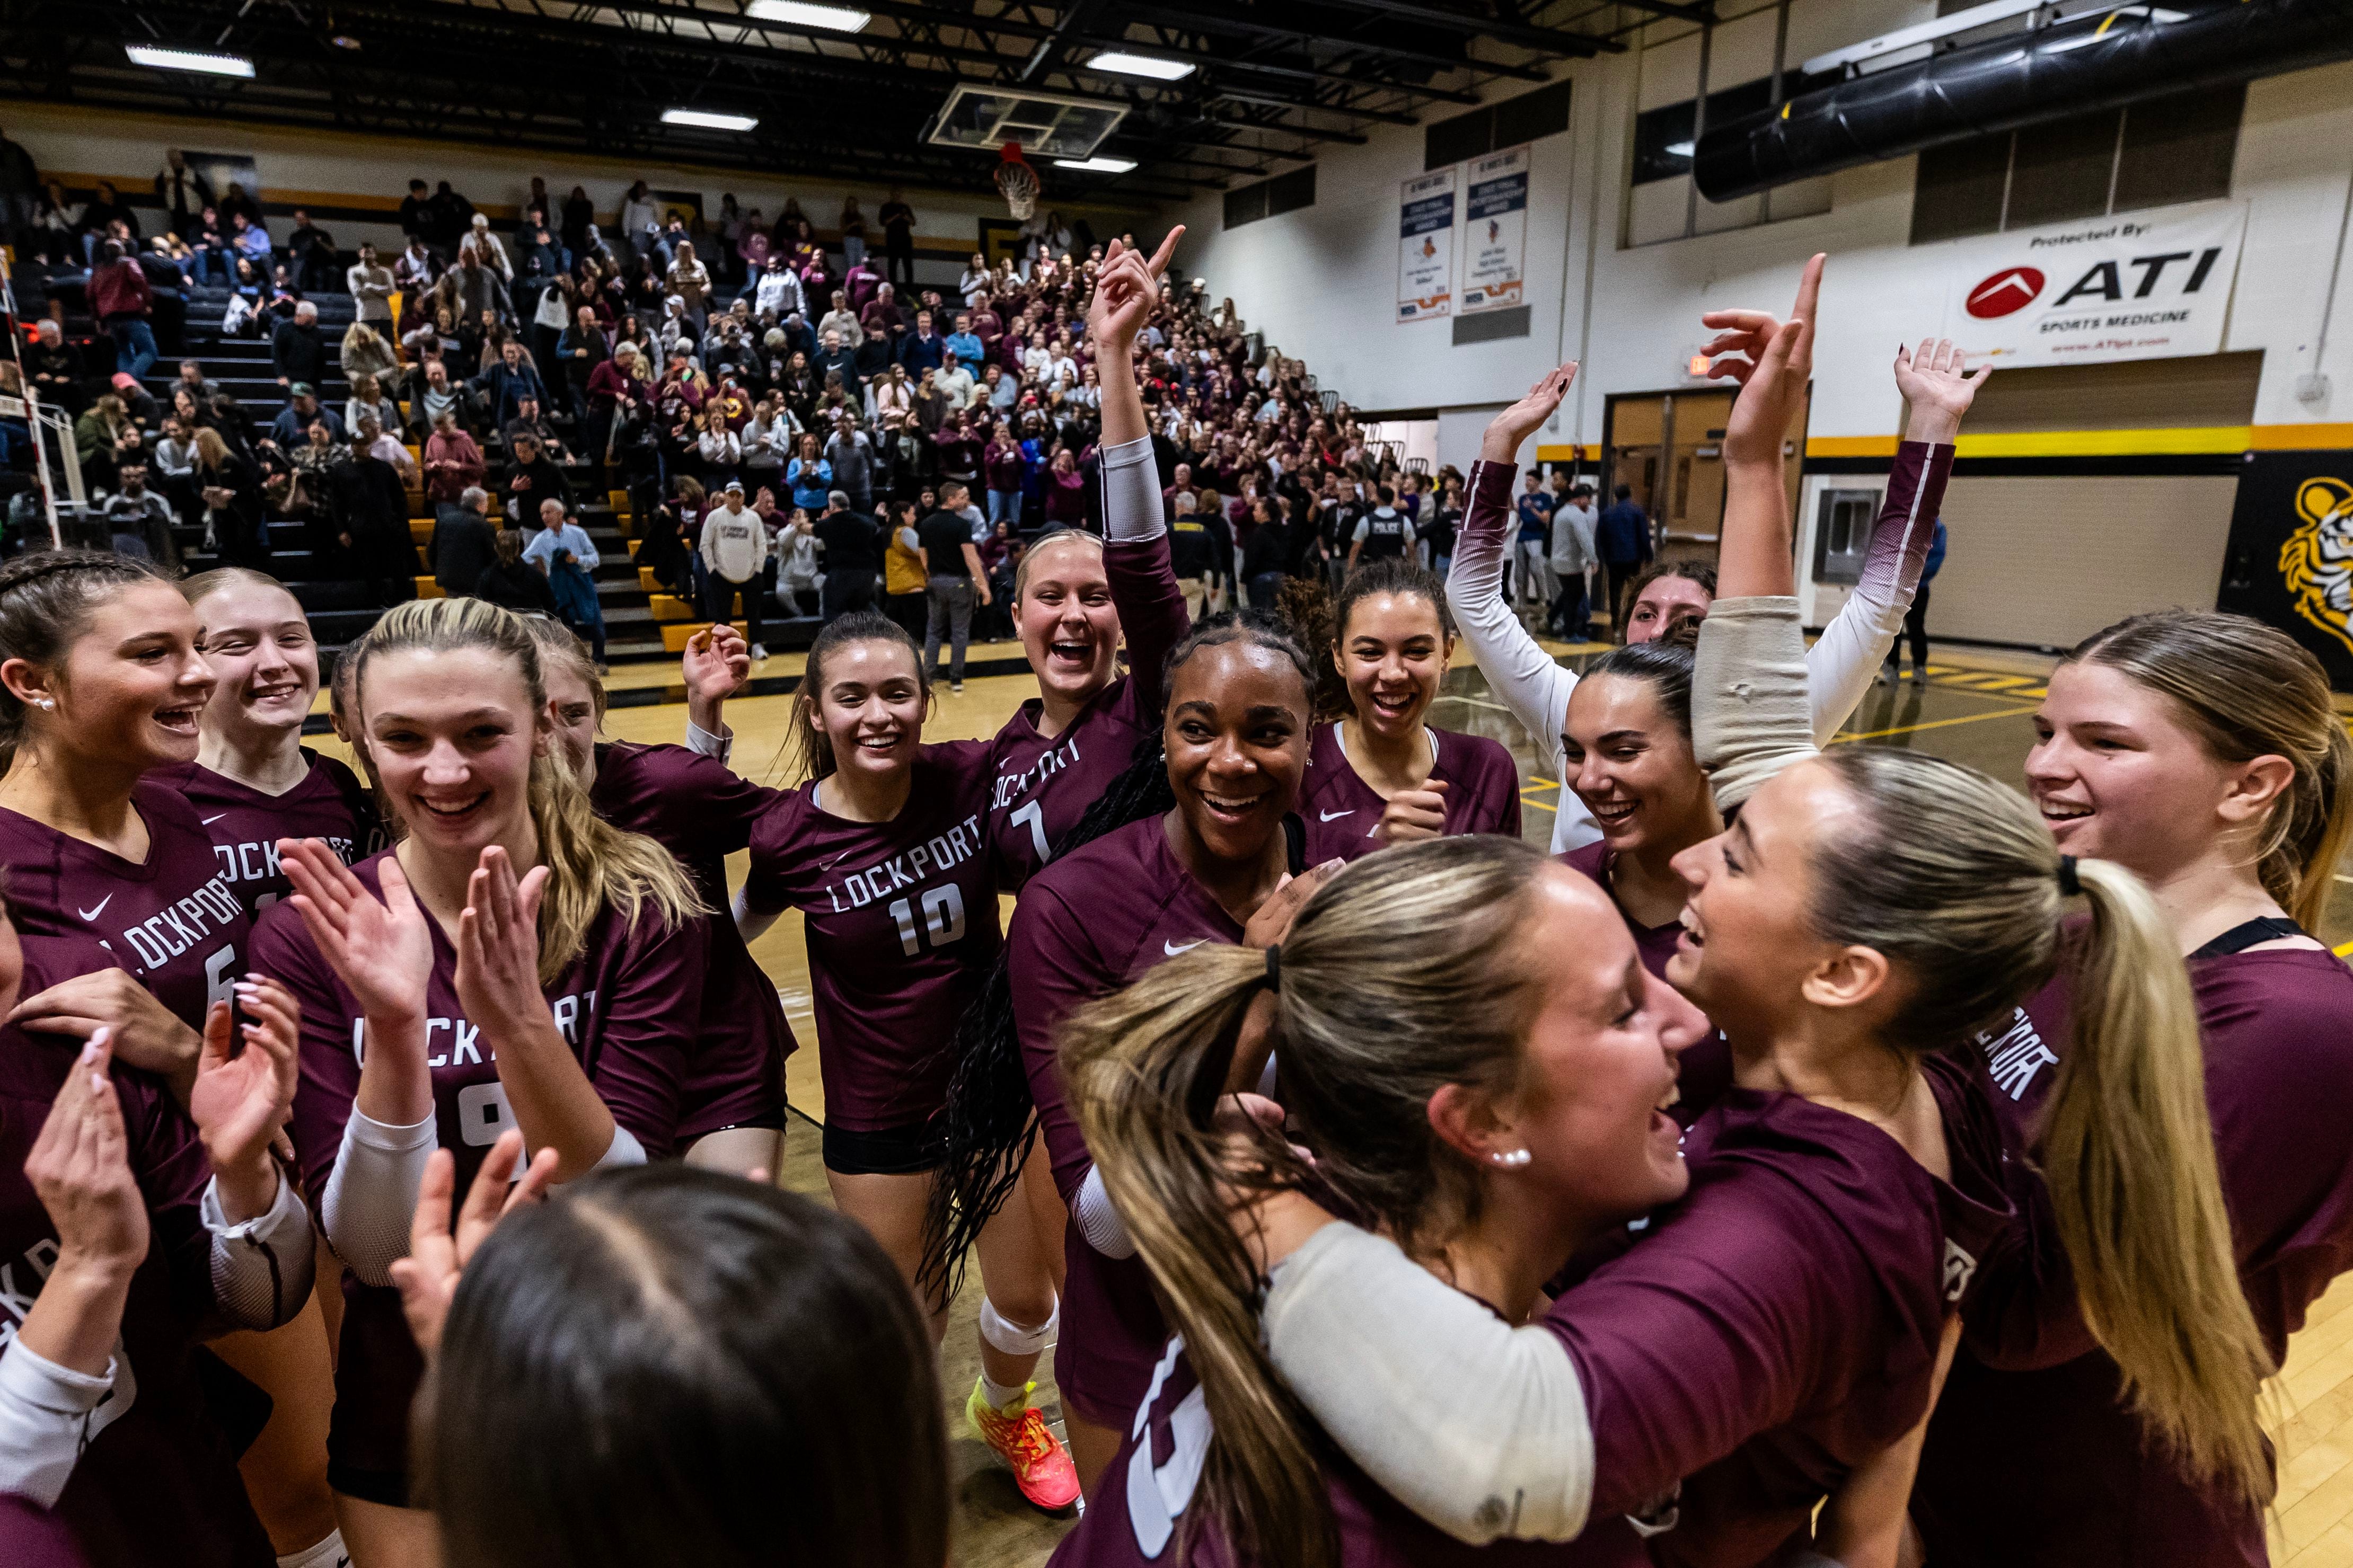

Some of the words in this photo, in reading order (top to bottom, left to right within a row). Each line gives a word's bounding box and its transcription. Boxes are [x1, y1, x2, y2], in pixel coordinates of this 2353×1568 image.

[2030, 225, 2118, 250] Protected
[2052, 247, 2223, 307] ATI
[2040, 318, 2101, 334] SPORTS
[2106, 308, 2191, 327] MEDICINE
[1009, 799, 1051, 863] 7
[826, 814, 983, 913] LOCKPORT
[99, 870, 243, 975] OCKPOR
[888, 883, 965, 956] 10
